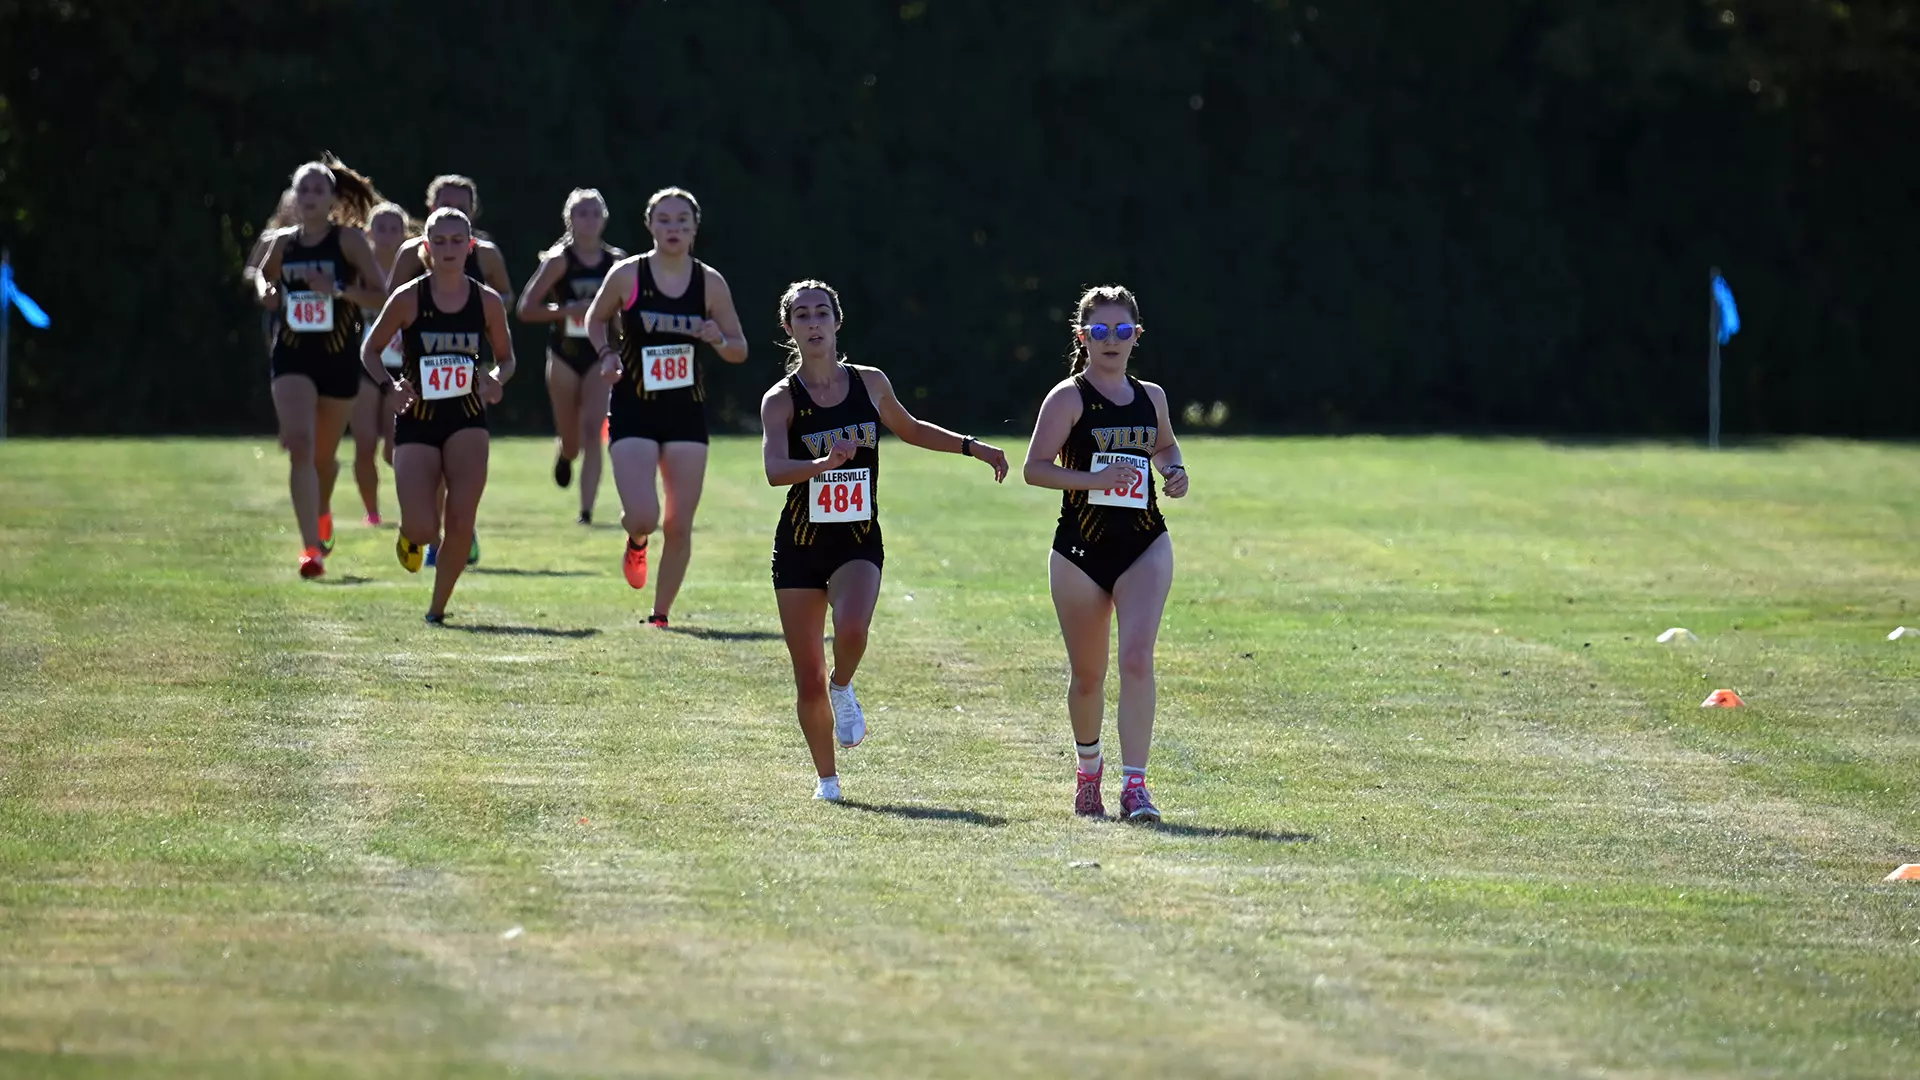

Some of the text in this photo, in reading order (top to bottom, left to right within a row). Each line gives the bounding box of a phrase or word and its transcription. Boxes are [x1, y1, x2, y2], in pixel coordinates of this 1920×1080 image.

[420, 332, 480, 355] VILLE
[429, 366, 467, 391] 476
[651, 356, 688, 381] 488
[1091, 426, 1157, 455] VILLE
[814, 470, 867, 483] MILLERSVILLE
[817, 482, 864, 513] 484
